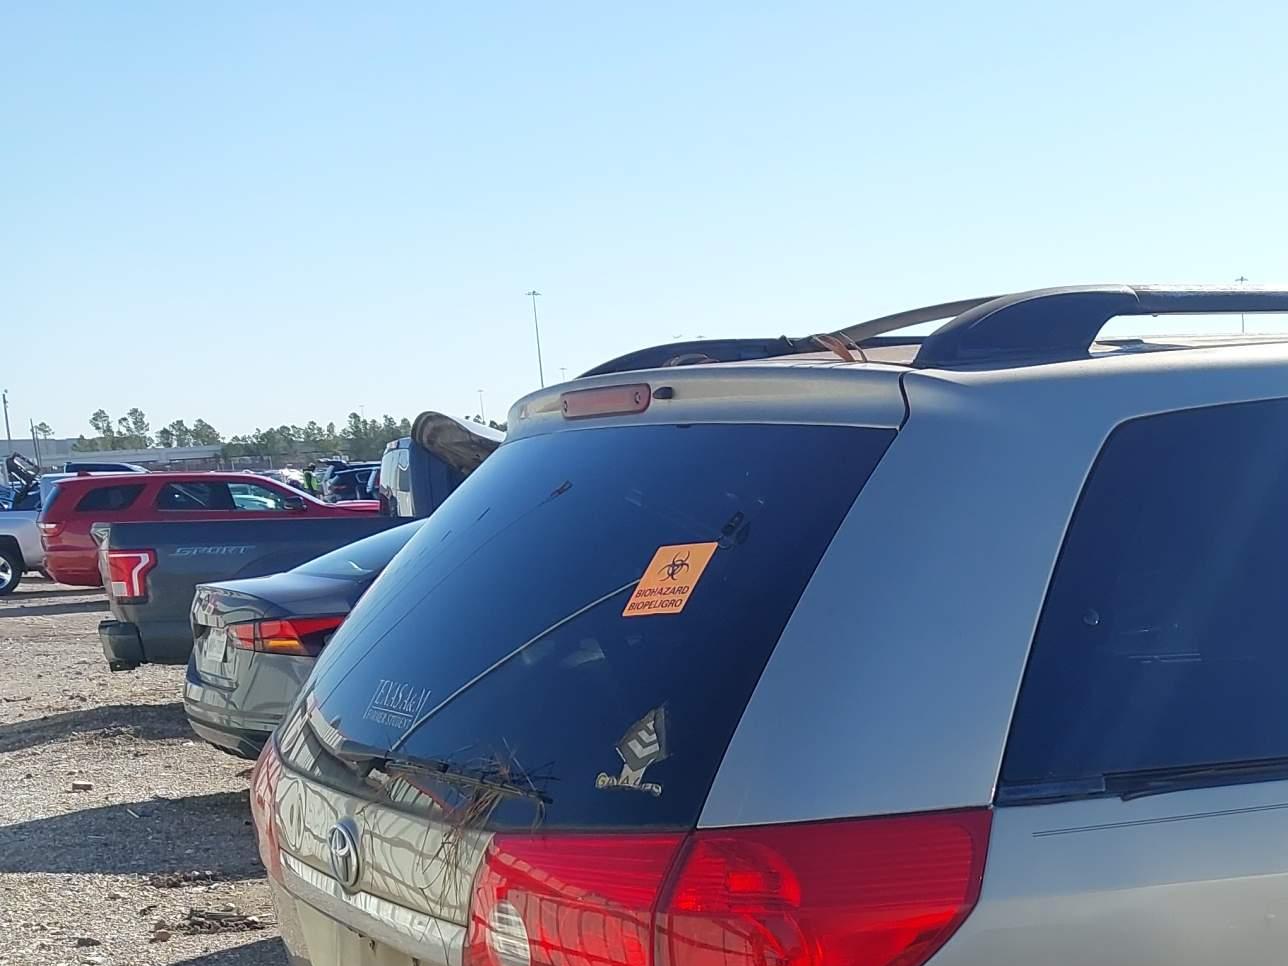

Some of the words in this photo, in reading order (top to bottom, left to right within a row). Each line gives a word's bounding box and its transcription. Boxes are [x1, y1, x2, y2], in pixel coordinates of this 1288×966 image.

[169, 545, 256, 556] SPORT
[635, 586, 689, 598] BIOHAZARD
[628, 599, 682, 611] BIOPELIGRO
